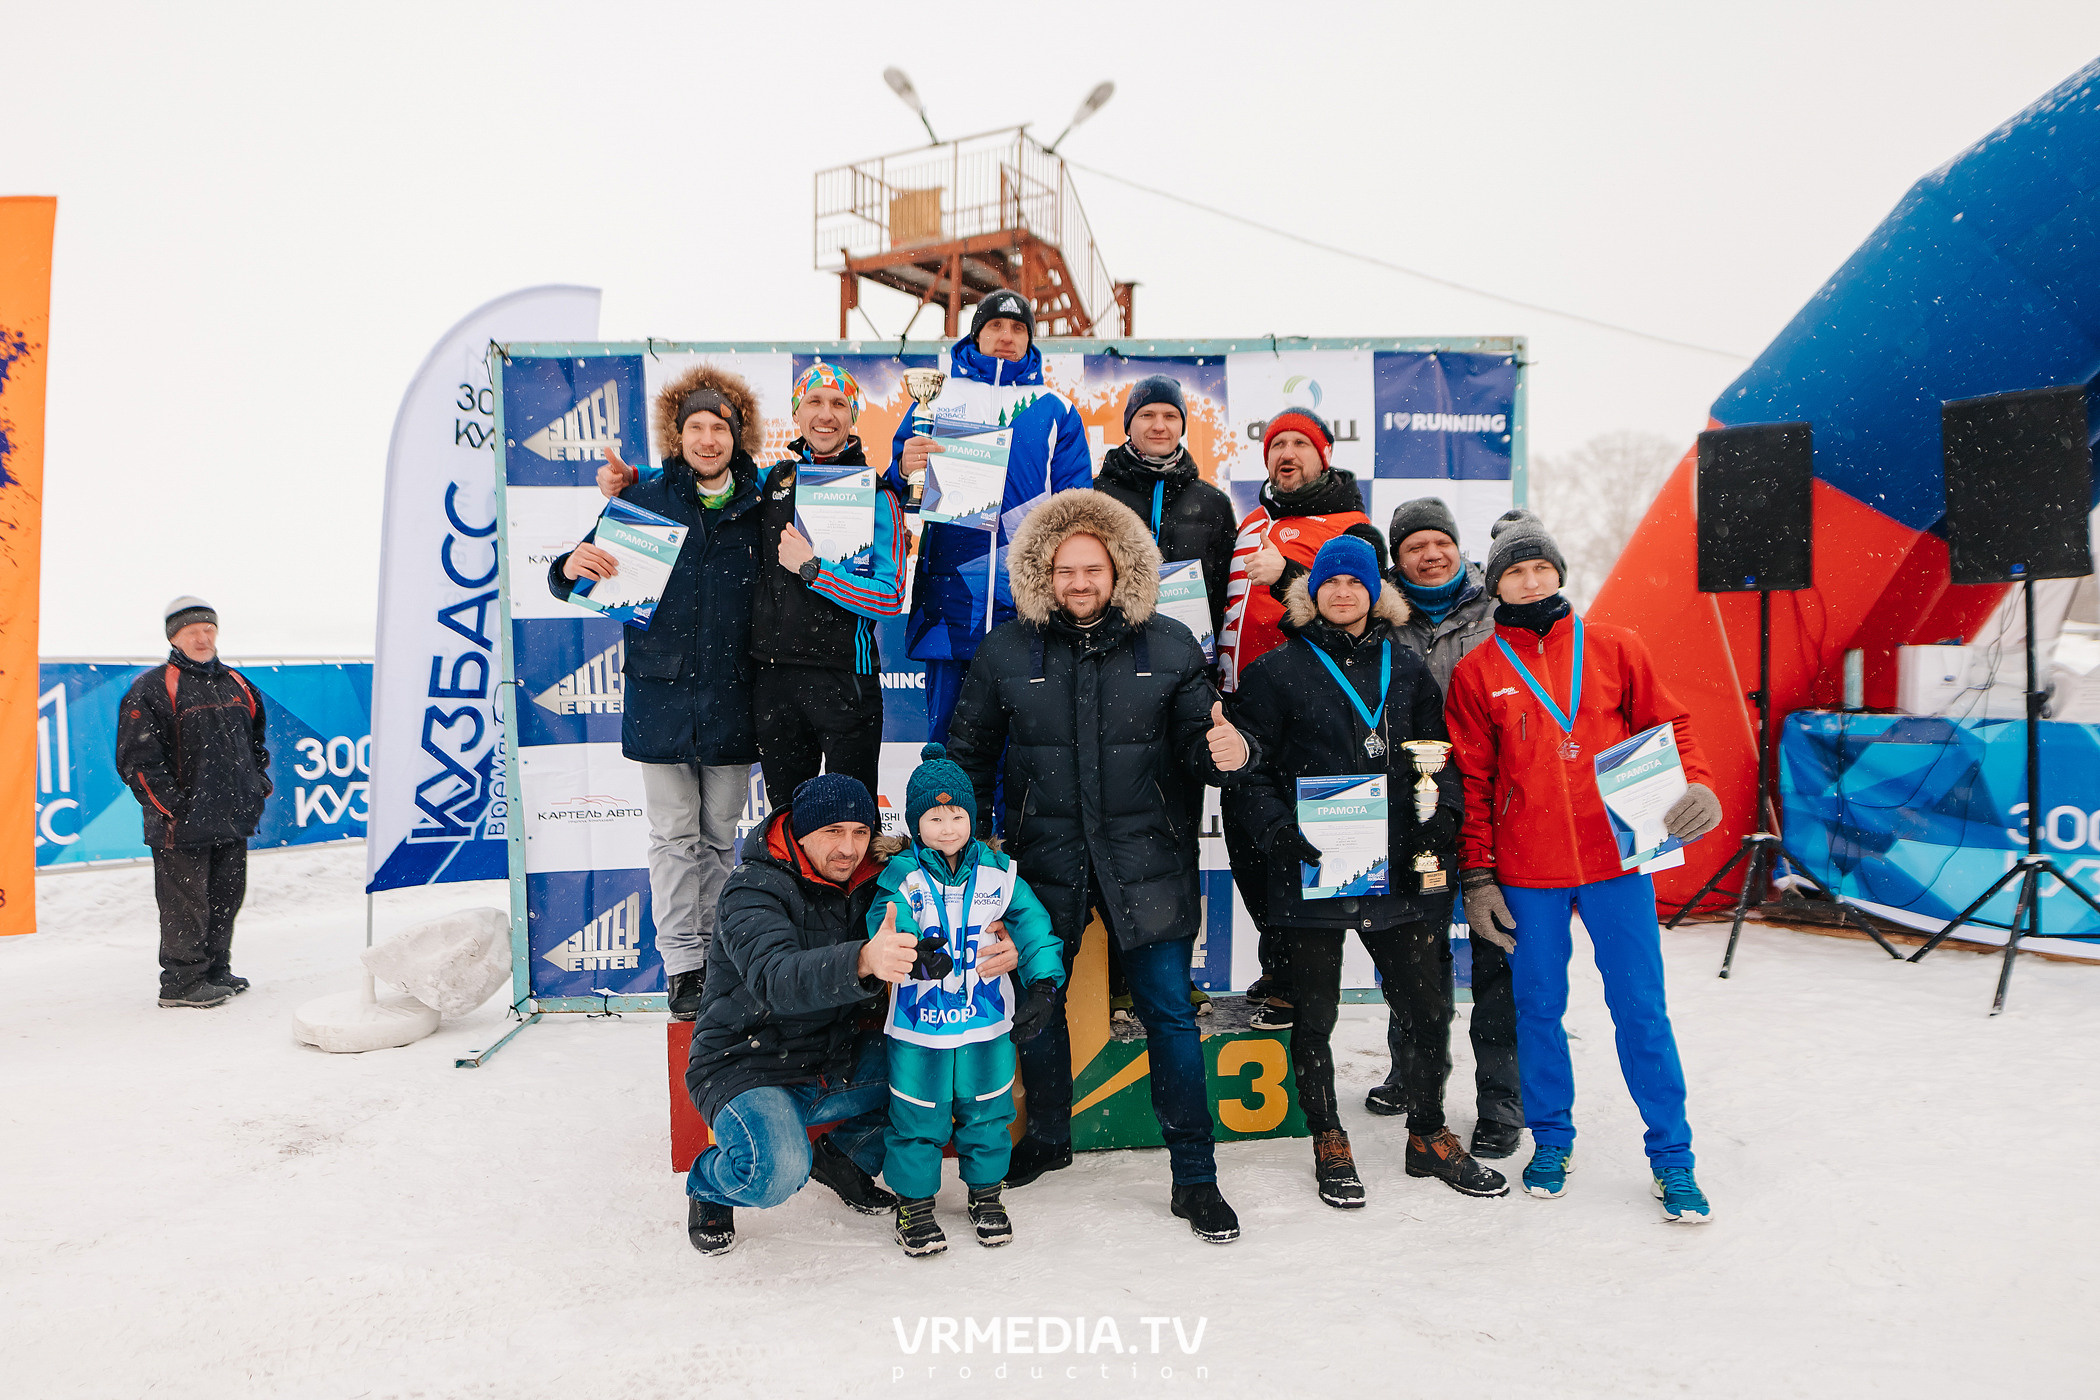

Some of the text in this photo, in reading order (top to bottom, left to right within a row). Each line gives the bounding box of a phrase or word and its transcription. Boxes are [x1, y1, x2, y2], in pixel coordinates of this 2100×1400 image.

[548, 379, 620, 440] ЭНТЕР
[1411, 411, 1507, 433] RUNNING
[947, 444, 992, 459] ГРАМОТА
[813, 492, 858, 502] ГРАМОТА
[615, 529, 660, 554] ГРАМОТА
[411, 479, 500, 839] КУЗБАСС
[560, 700, 625, 715] ENTE
[1615, 758, 1662, 783] ГРАМОТА
[537, 808, 643, 820] КАРТЕЛЬ АВТО
[1317, 805, 1368, 815] ГРАМОТА
[568, 891, 639, 952] ЭНТЕР
[568, 955, 639, 972] ENTER
[1217, 1038, 1288, 1133] 3
